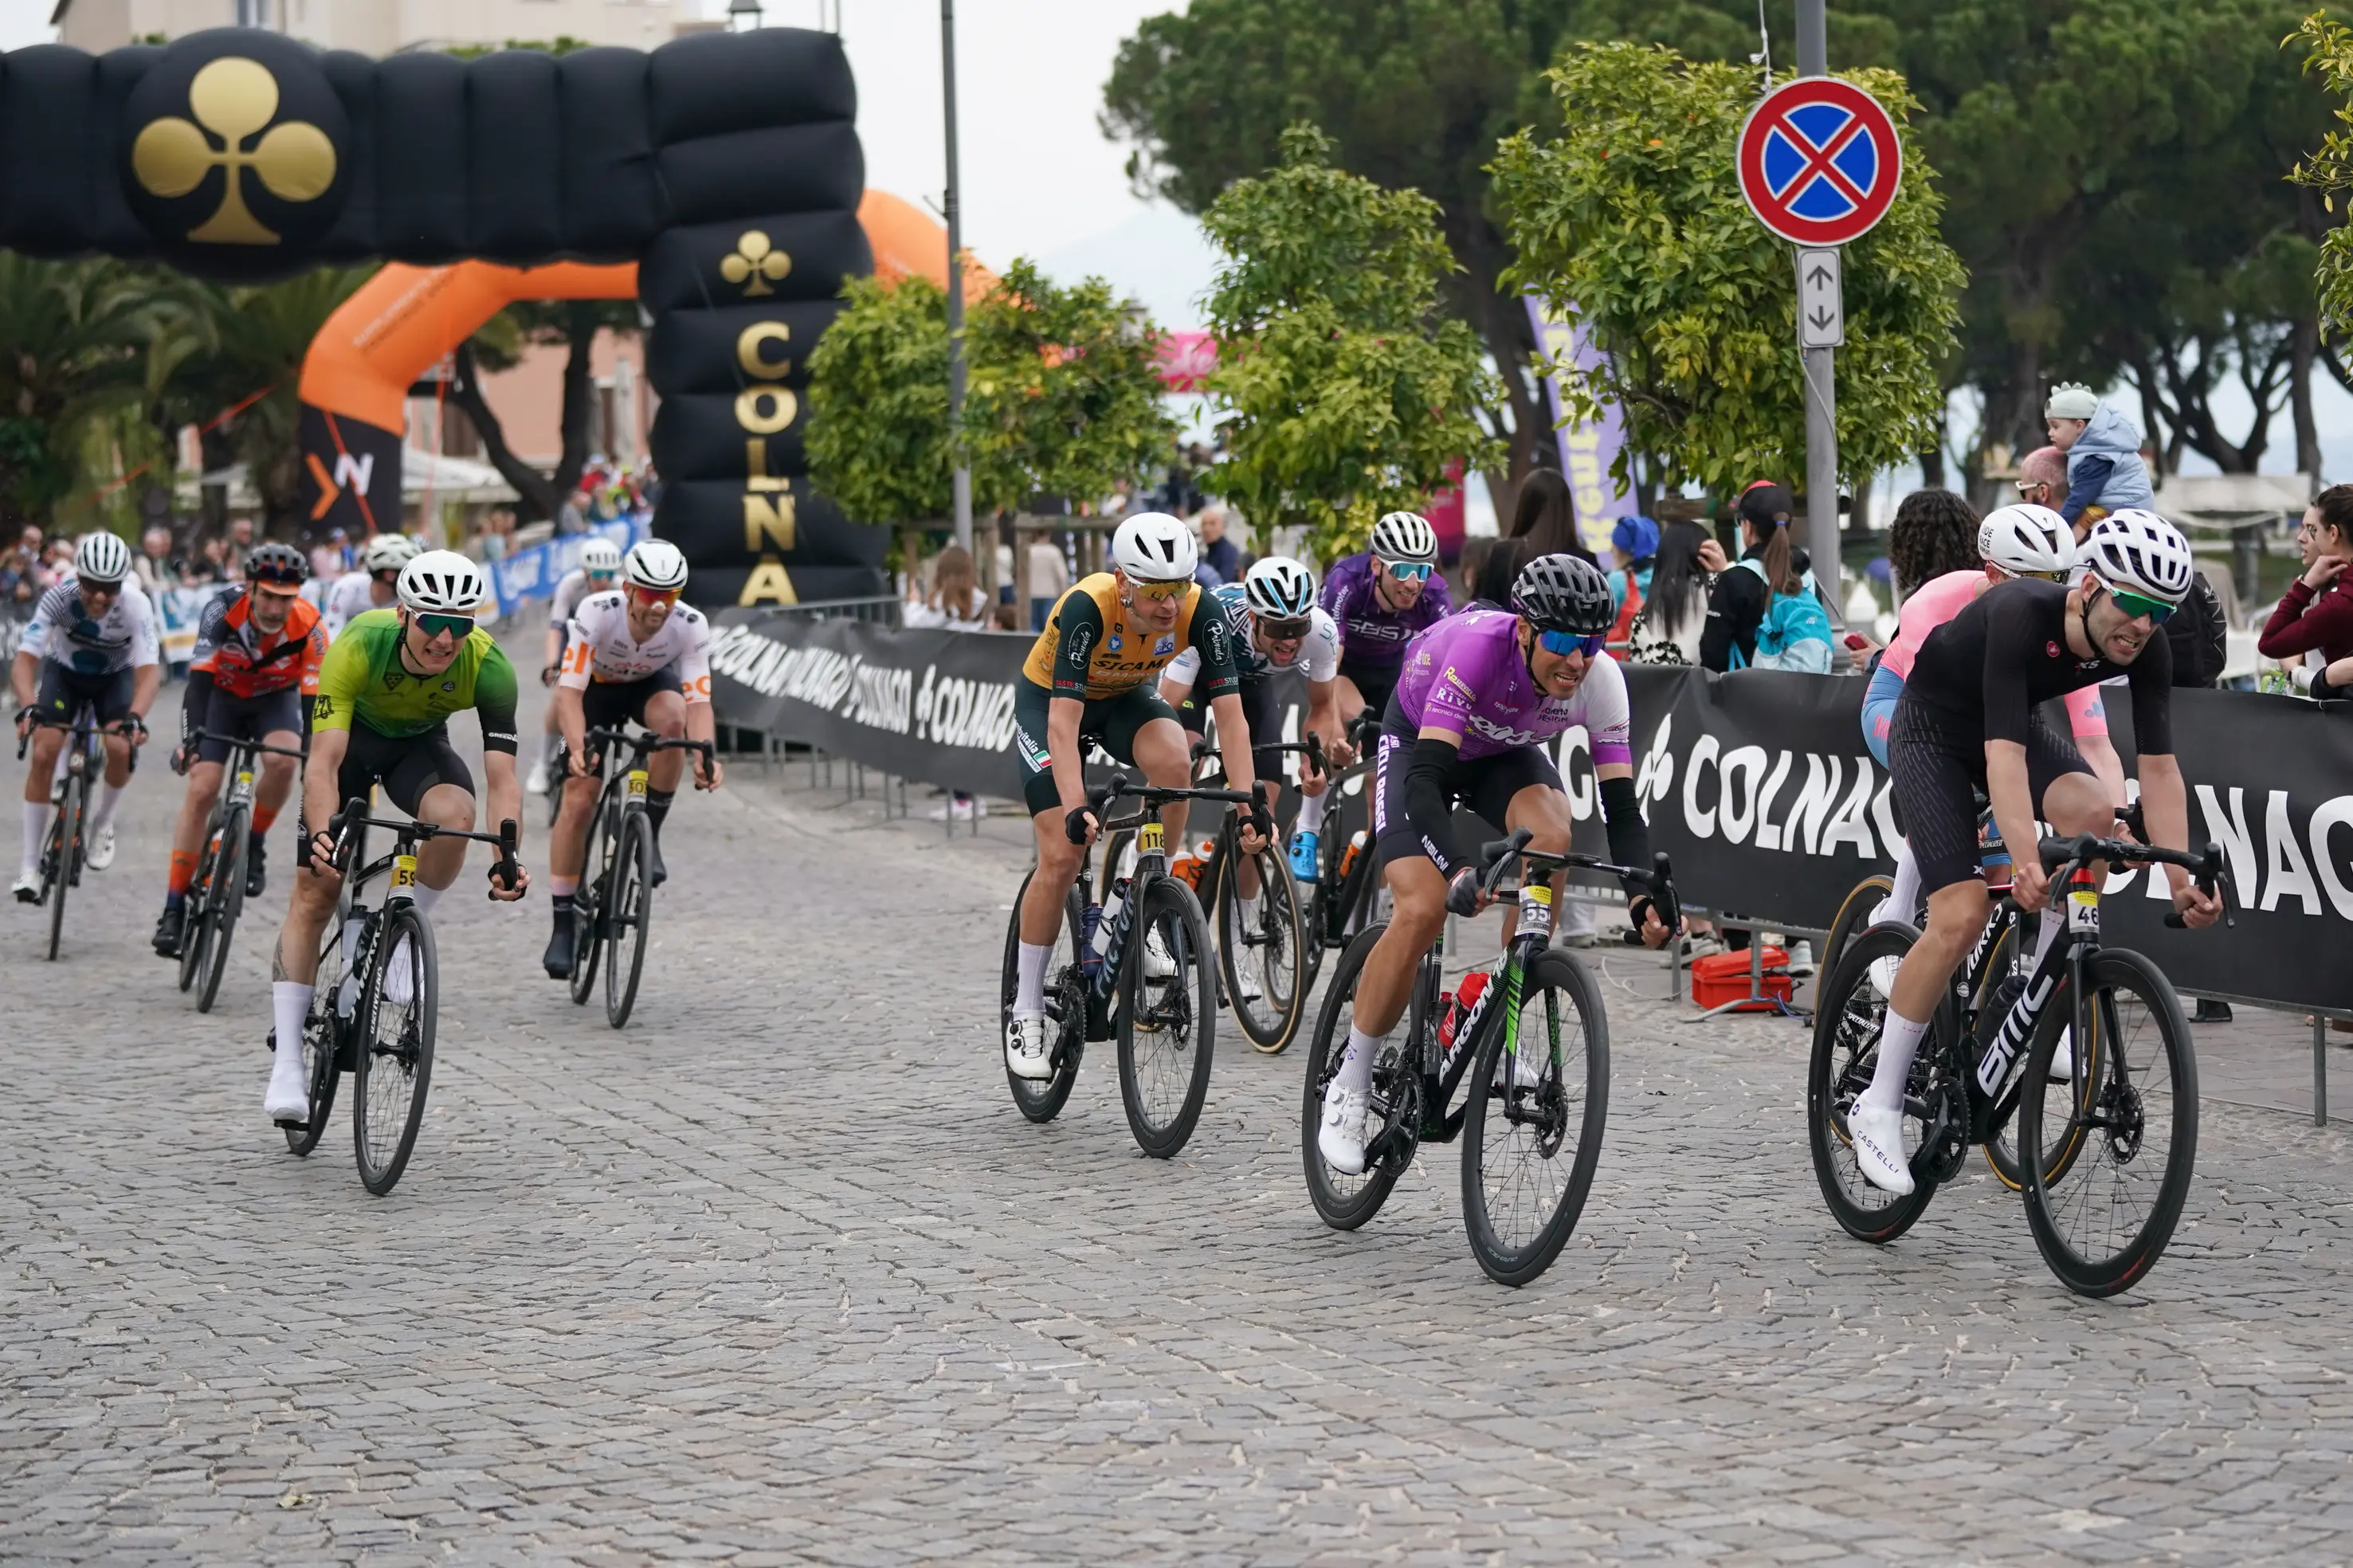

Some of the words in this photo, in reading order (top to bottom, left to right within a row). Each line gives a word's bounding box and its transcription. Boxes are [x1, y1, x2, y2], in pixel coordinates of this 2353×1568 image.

[1155, 641, 1174, 653] GPO
[930, 676, 1016, 753] COLNAGO
[1377, 735, 1391, 778] CICLI
[1375, 778, 1388, 834] ROSSI
[2077, 906, 2099, 926] 46
[1439, 977, 1495, 1088] ARGON
[1846, 1012, 1880, 1033] SPECIALIZED
[1976, 974, 2054, 1098] BMC
[1857, 1130, 1900, 1174] CASTELLI
